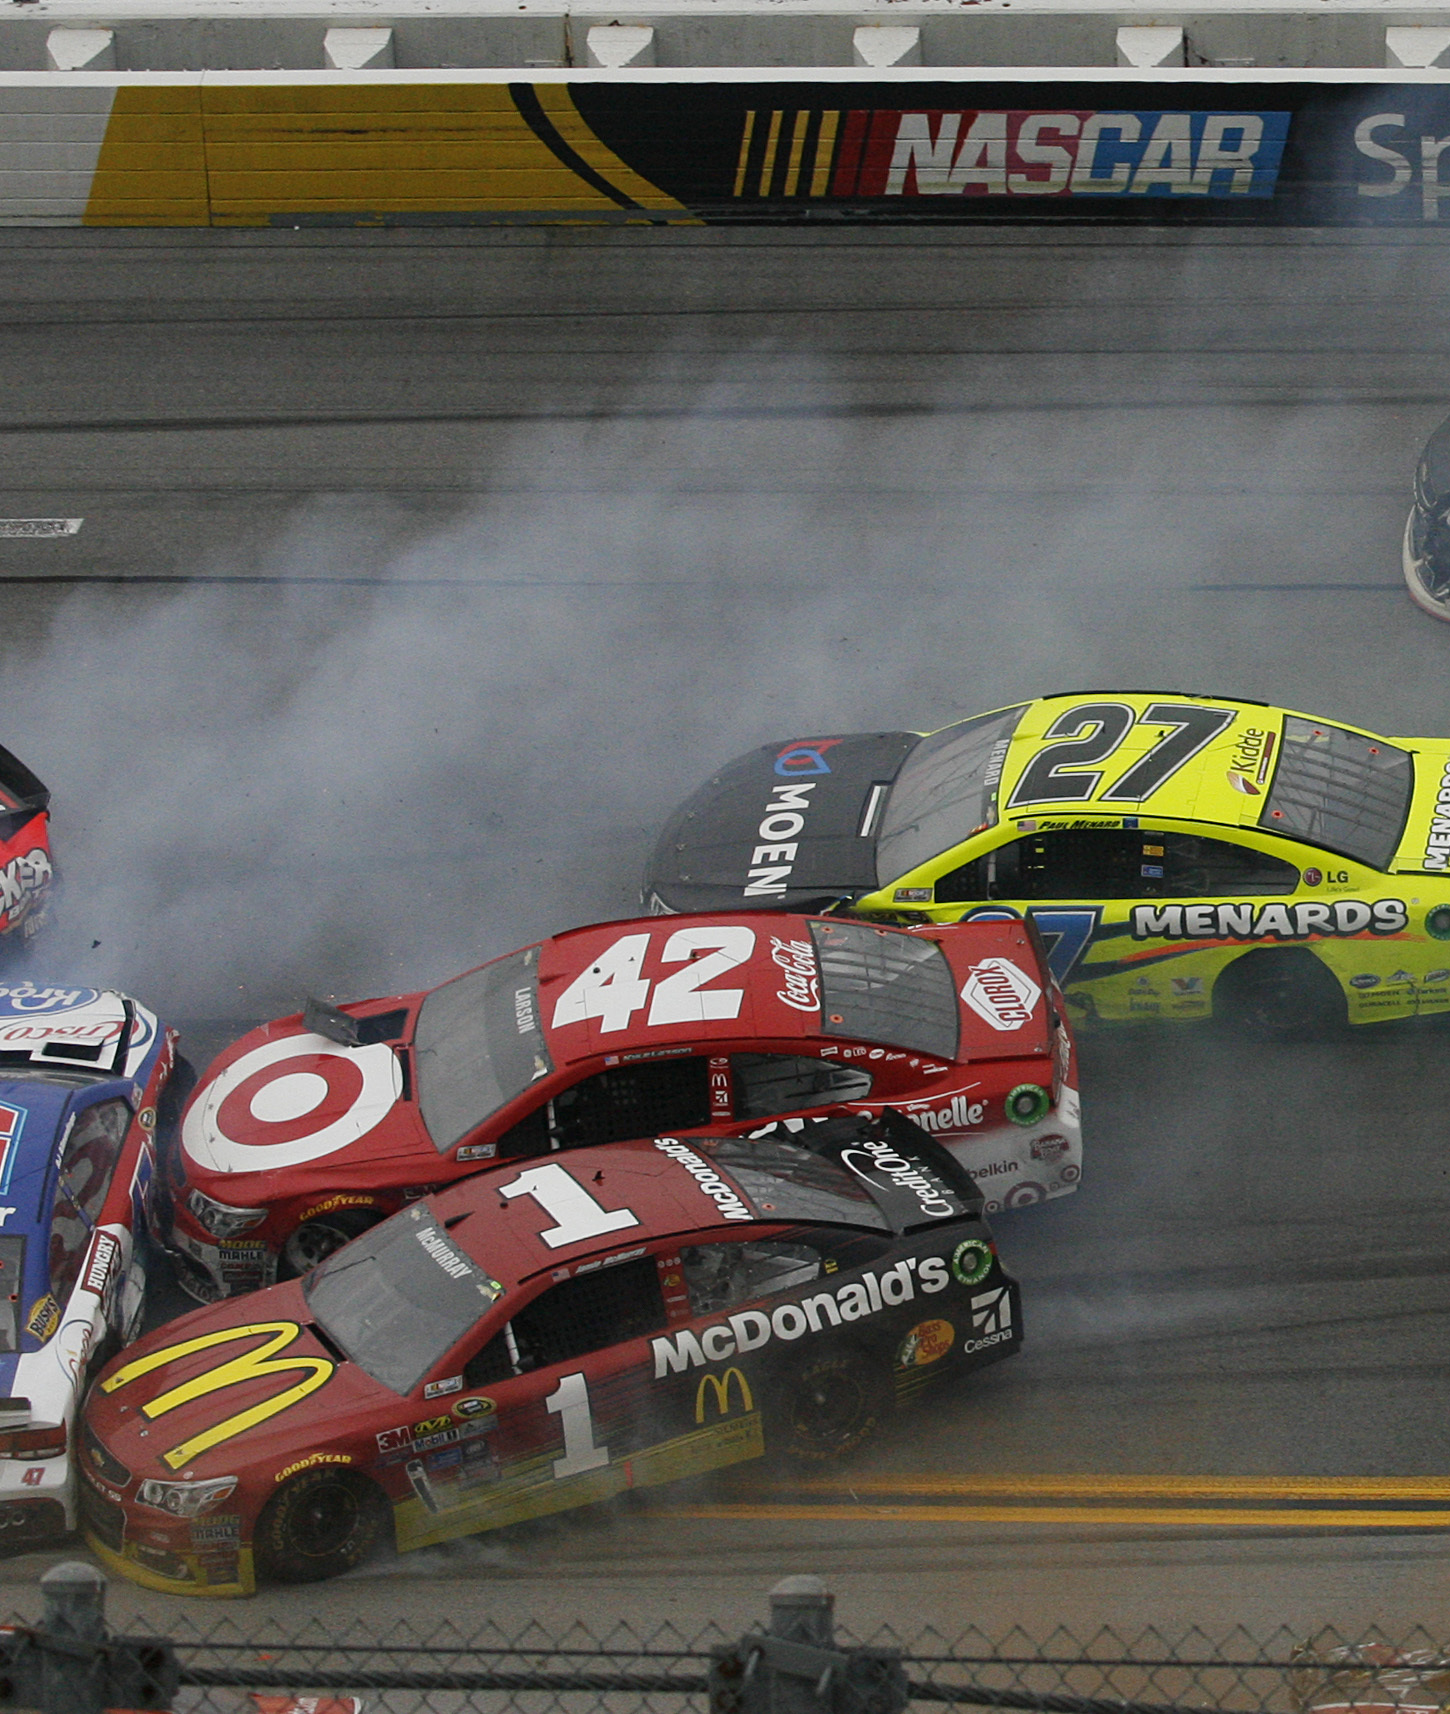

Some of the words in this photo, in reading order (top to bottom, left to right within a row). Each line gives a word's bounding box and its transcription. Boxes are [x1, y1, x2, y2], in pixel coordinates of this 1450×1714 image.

[885, 112, 1266, 195] NASCAR
[983, 738, 1010, 787] MENARD
[1005, 702, 1238, 811] 27
[1230, 727, 1264, 774] Kidde
[743, 782, 817, 898] MOEN
[1327, 871, 1349, 883] LG
[1134, 899, 1410, 937] MENARDS
[551, 926, 757, 1034] 42
[776, 935, 821, 1012] Coca-Cola
[968, 965, 1033, 1023] CLOROX
[514, 987, 536, 1035] LARSON
[967, 1160, 1019, 1180] belkin
[299, 1194, 374, 1222] GOODYEAR
[498, 1162, 641, 1250] 1
[87, 1234, 116, 1291] HUNGRY
[416, 1227, 472, 1280] McMURRAY
[953, 1239, 989, 1265] AMERICAN
[30, 1297, 58, 1337] BUSH'S
[652, 1256, 950, 1380] McDonald's
[964, 1327, 1013, 1354] Cessna
[379, 1430, 410, 1451] 3M
[415, 1435, 445, 1449] Mobil
[546, 1372, 610, 1480] 1
[21, 1466, 46, 1486] 47
[274, 1453, 353, 1483] GOODYEAR
